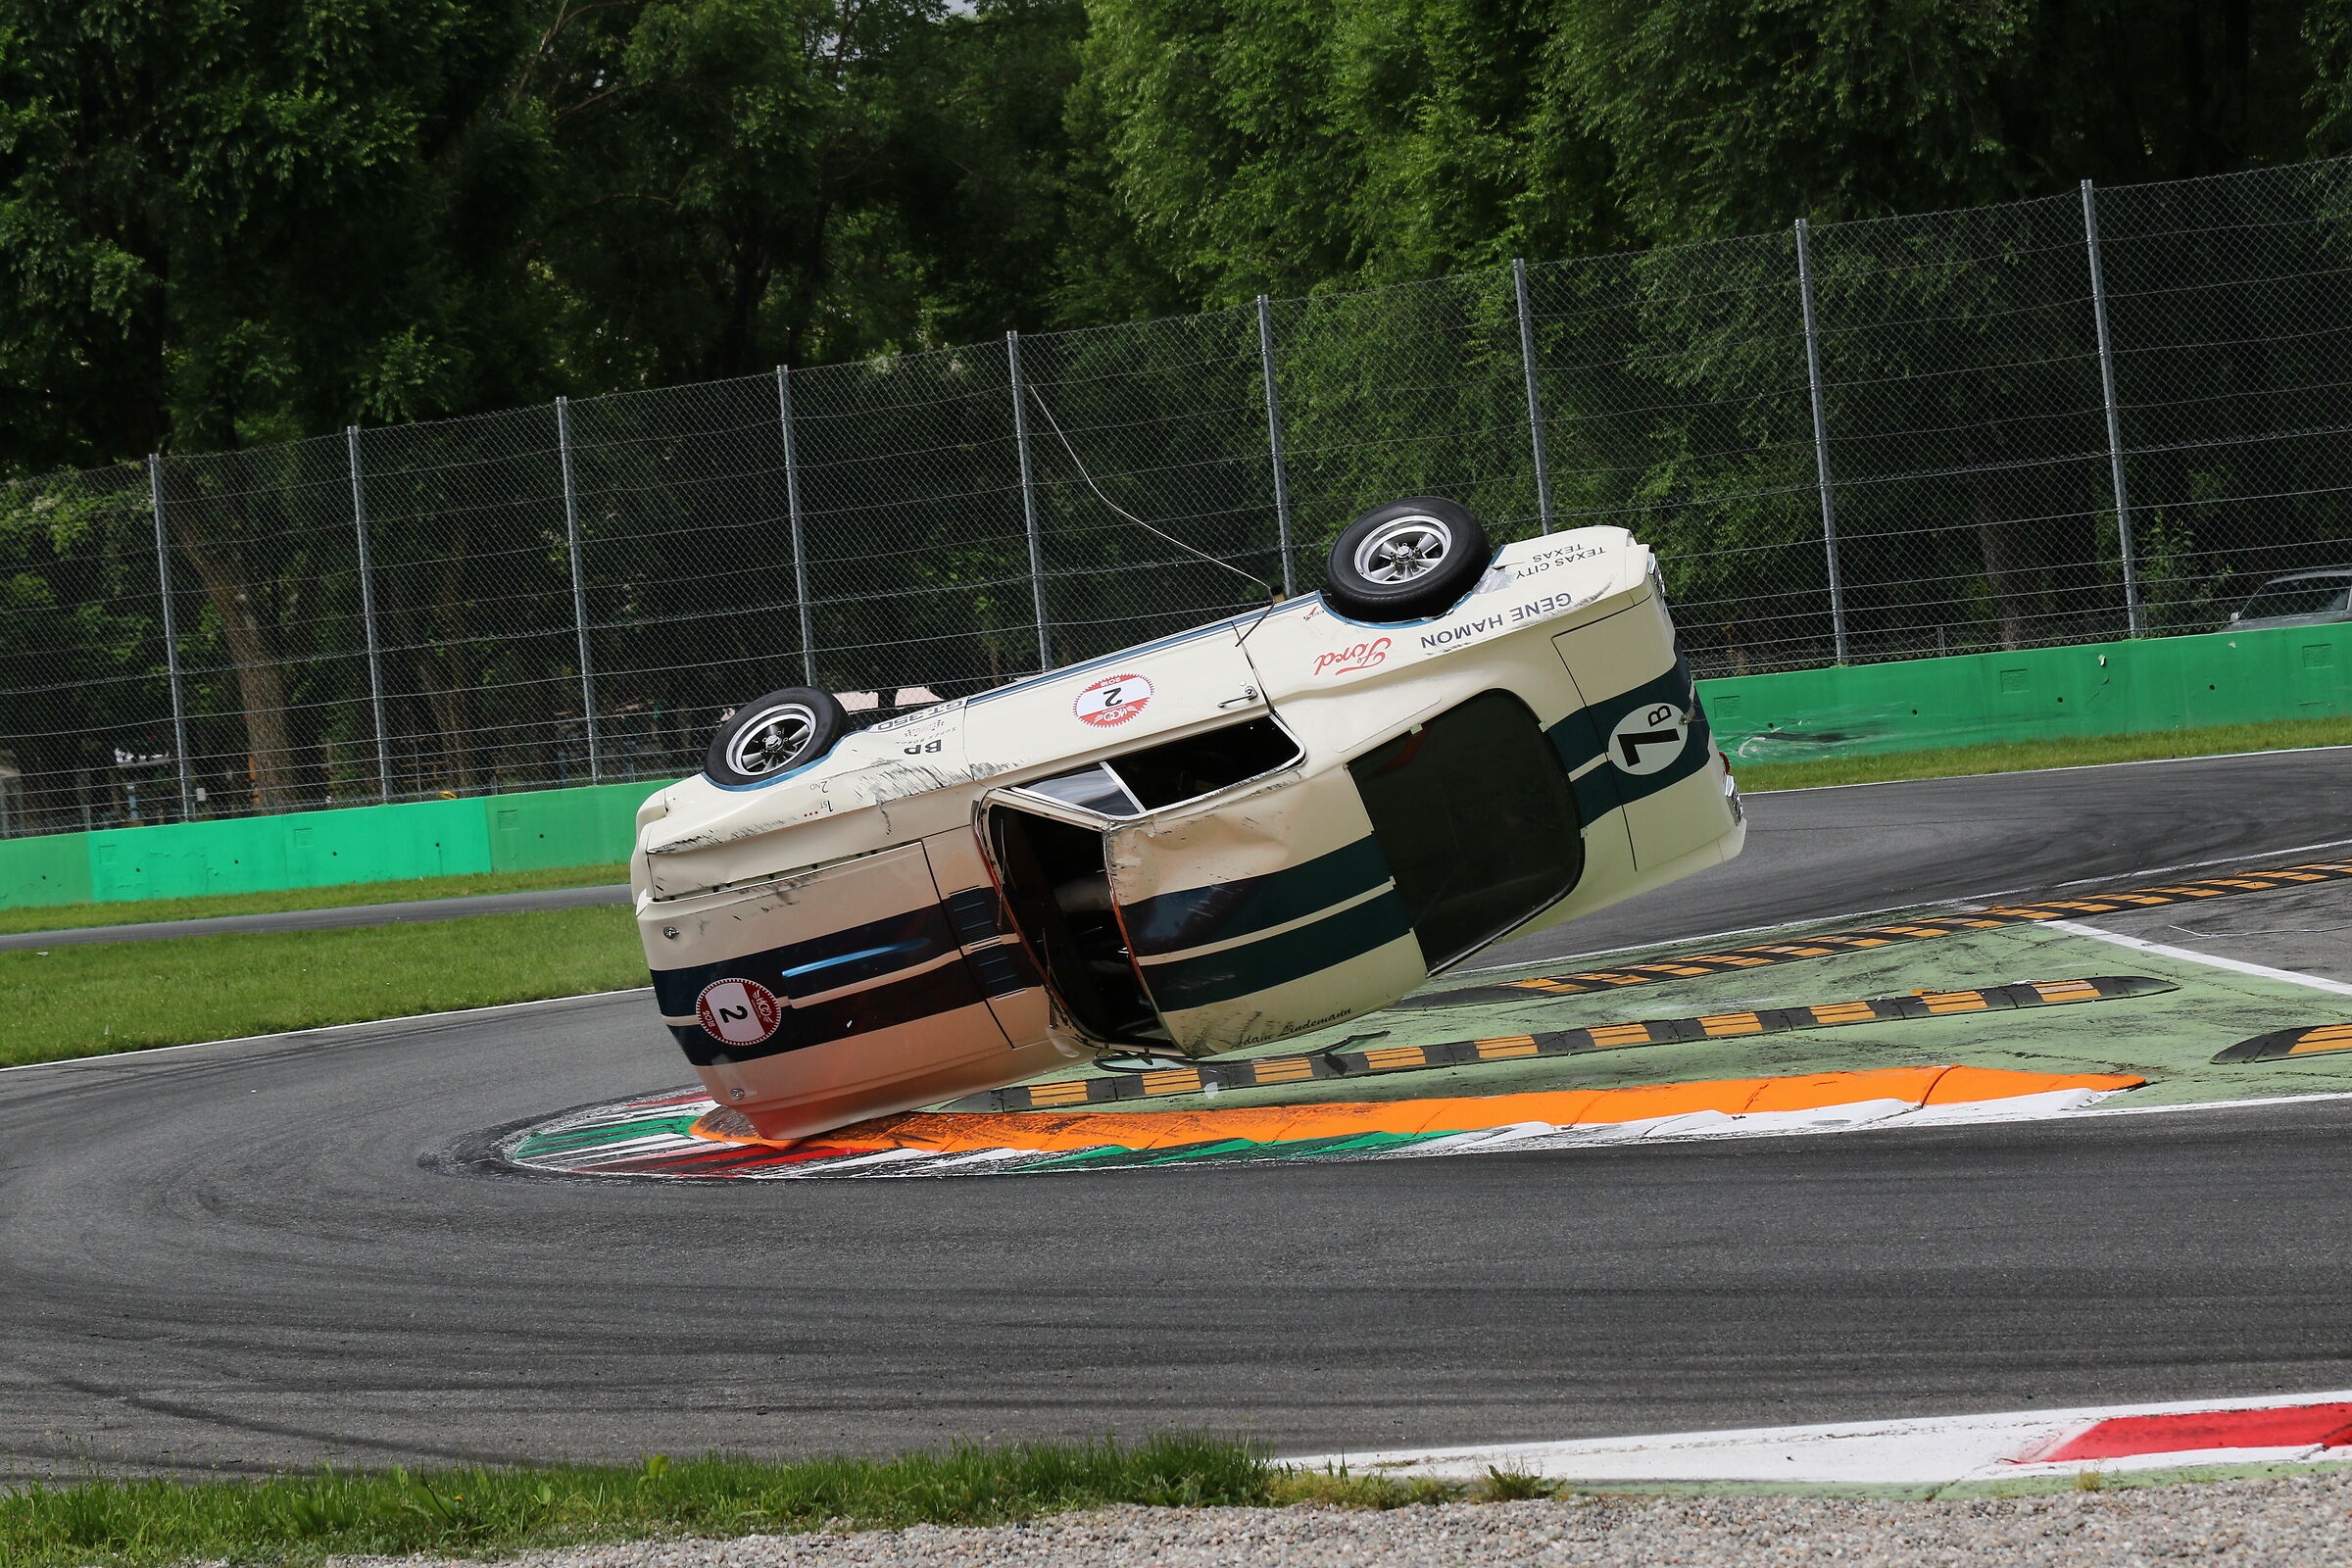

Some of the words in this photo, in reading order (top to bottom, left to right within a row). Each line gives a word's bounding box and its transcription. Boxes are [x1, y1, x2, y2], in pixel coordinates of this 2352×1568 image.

[1532, 542, 1585, 564] TEXAS
[1555, 545, 1607, 567] TEXAS
[1515, 562, 1550, 581] CITY
[1509, 591, 1572, 623] GENE
[1420, 613, 1504, 650] HAMON
[1313, 636, 1393, 676] Ford
[1102, 687, 1123, 708] 2
[877, 711, 925, 731] 350
[1647, 705, 1672, 728] B
[904, 738, 942, 756] BP
[1616, 728, 1681, 768] 7
[702, 1010, 716, 1028] 2018
[718, 1004, 749, 1024] 2
[1277, 1006, 1352, 1038] Lindemann
